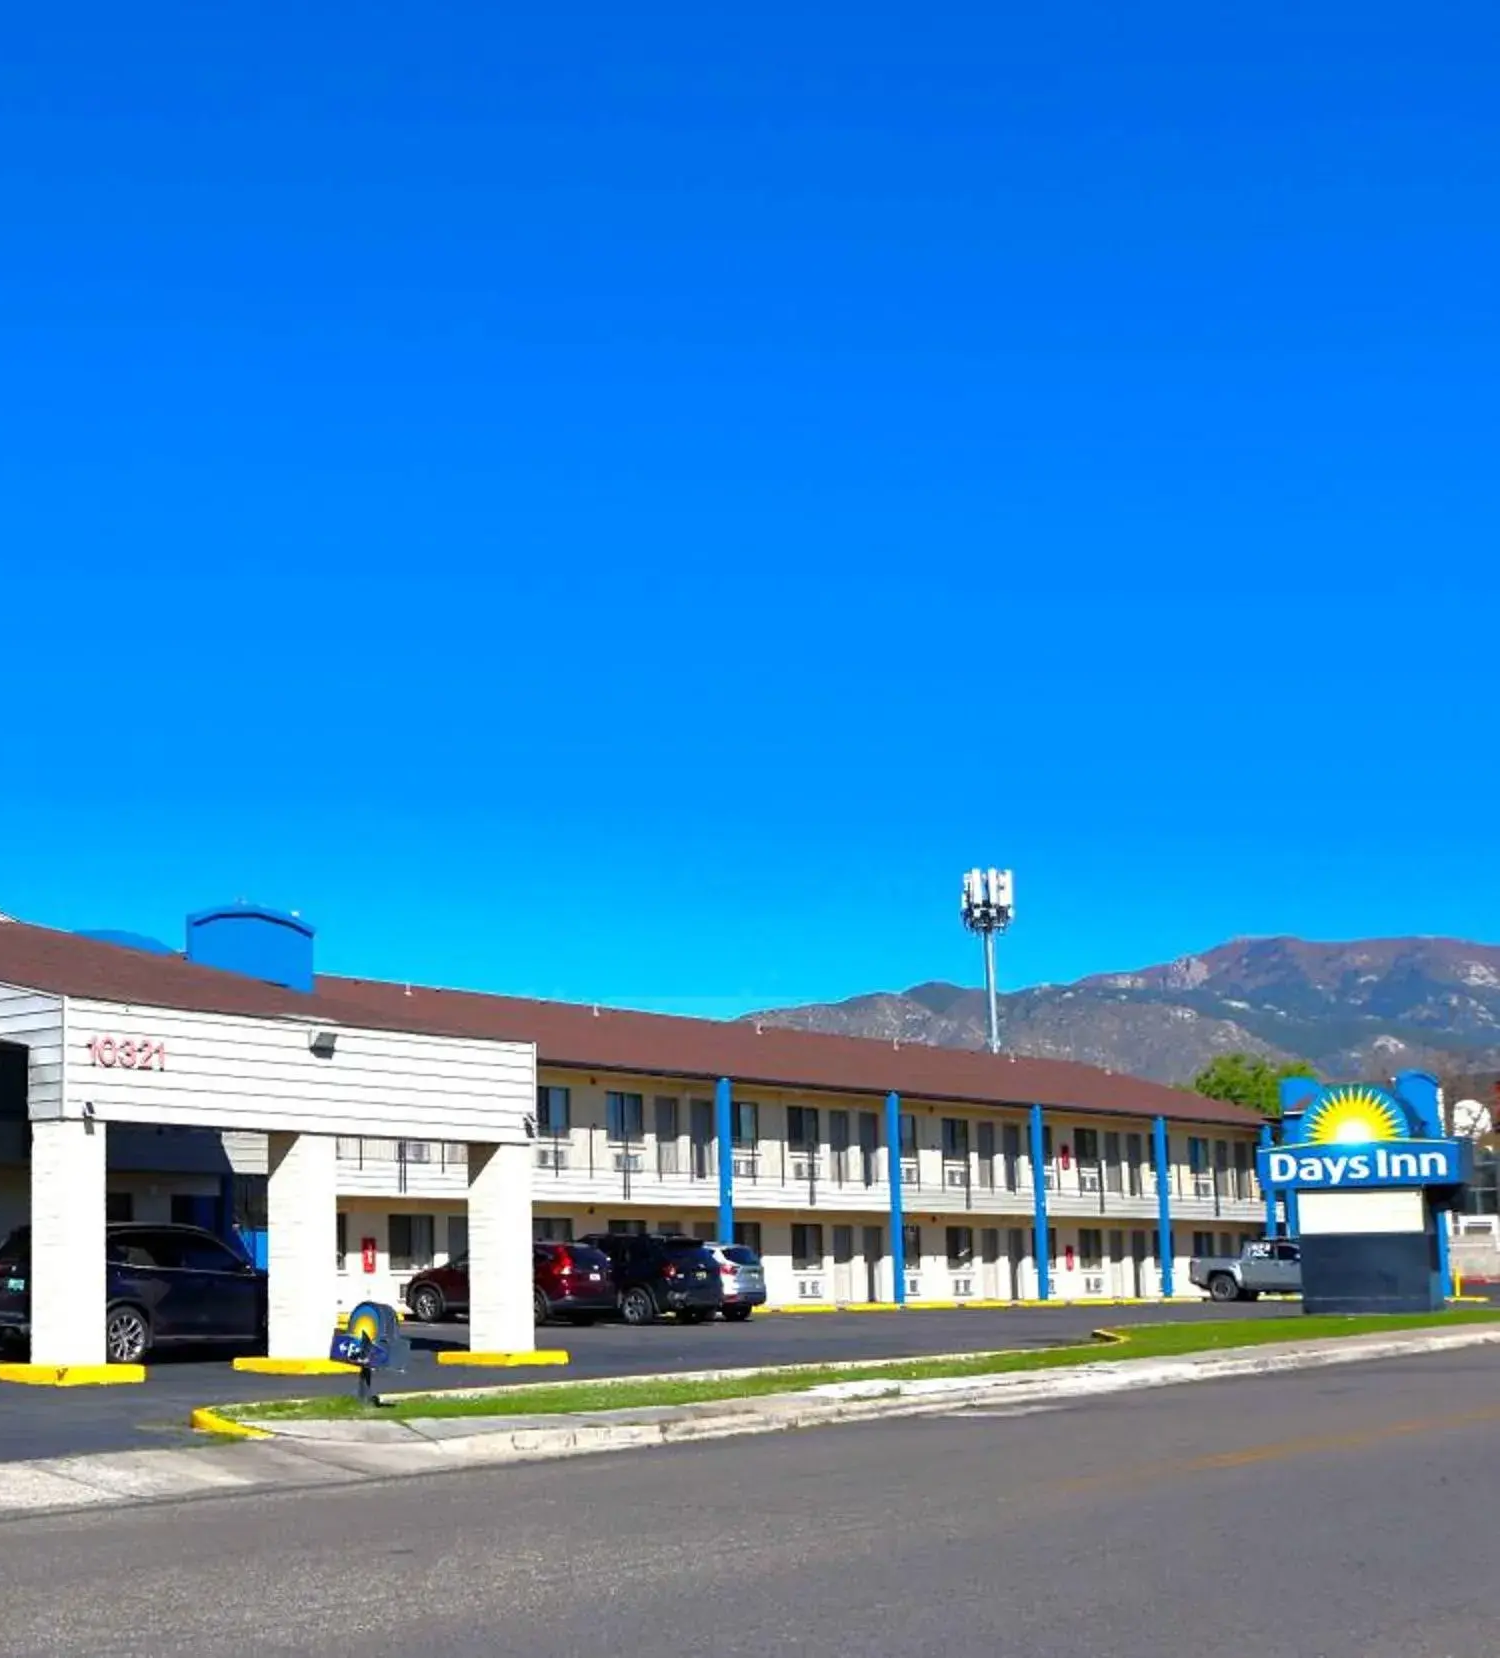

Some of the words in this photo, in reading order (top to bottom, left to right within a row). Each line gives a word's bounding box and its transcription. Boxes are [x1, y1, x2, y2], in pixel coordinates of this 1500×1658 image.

[86, 1036, 166, 1072] 10321
[1269, 1152, 1370, 1185] Days
[1376, 1149, 1448, 1178] Inn
